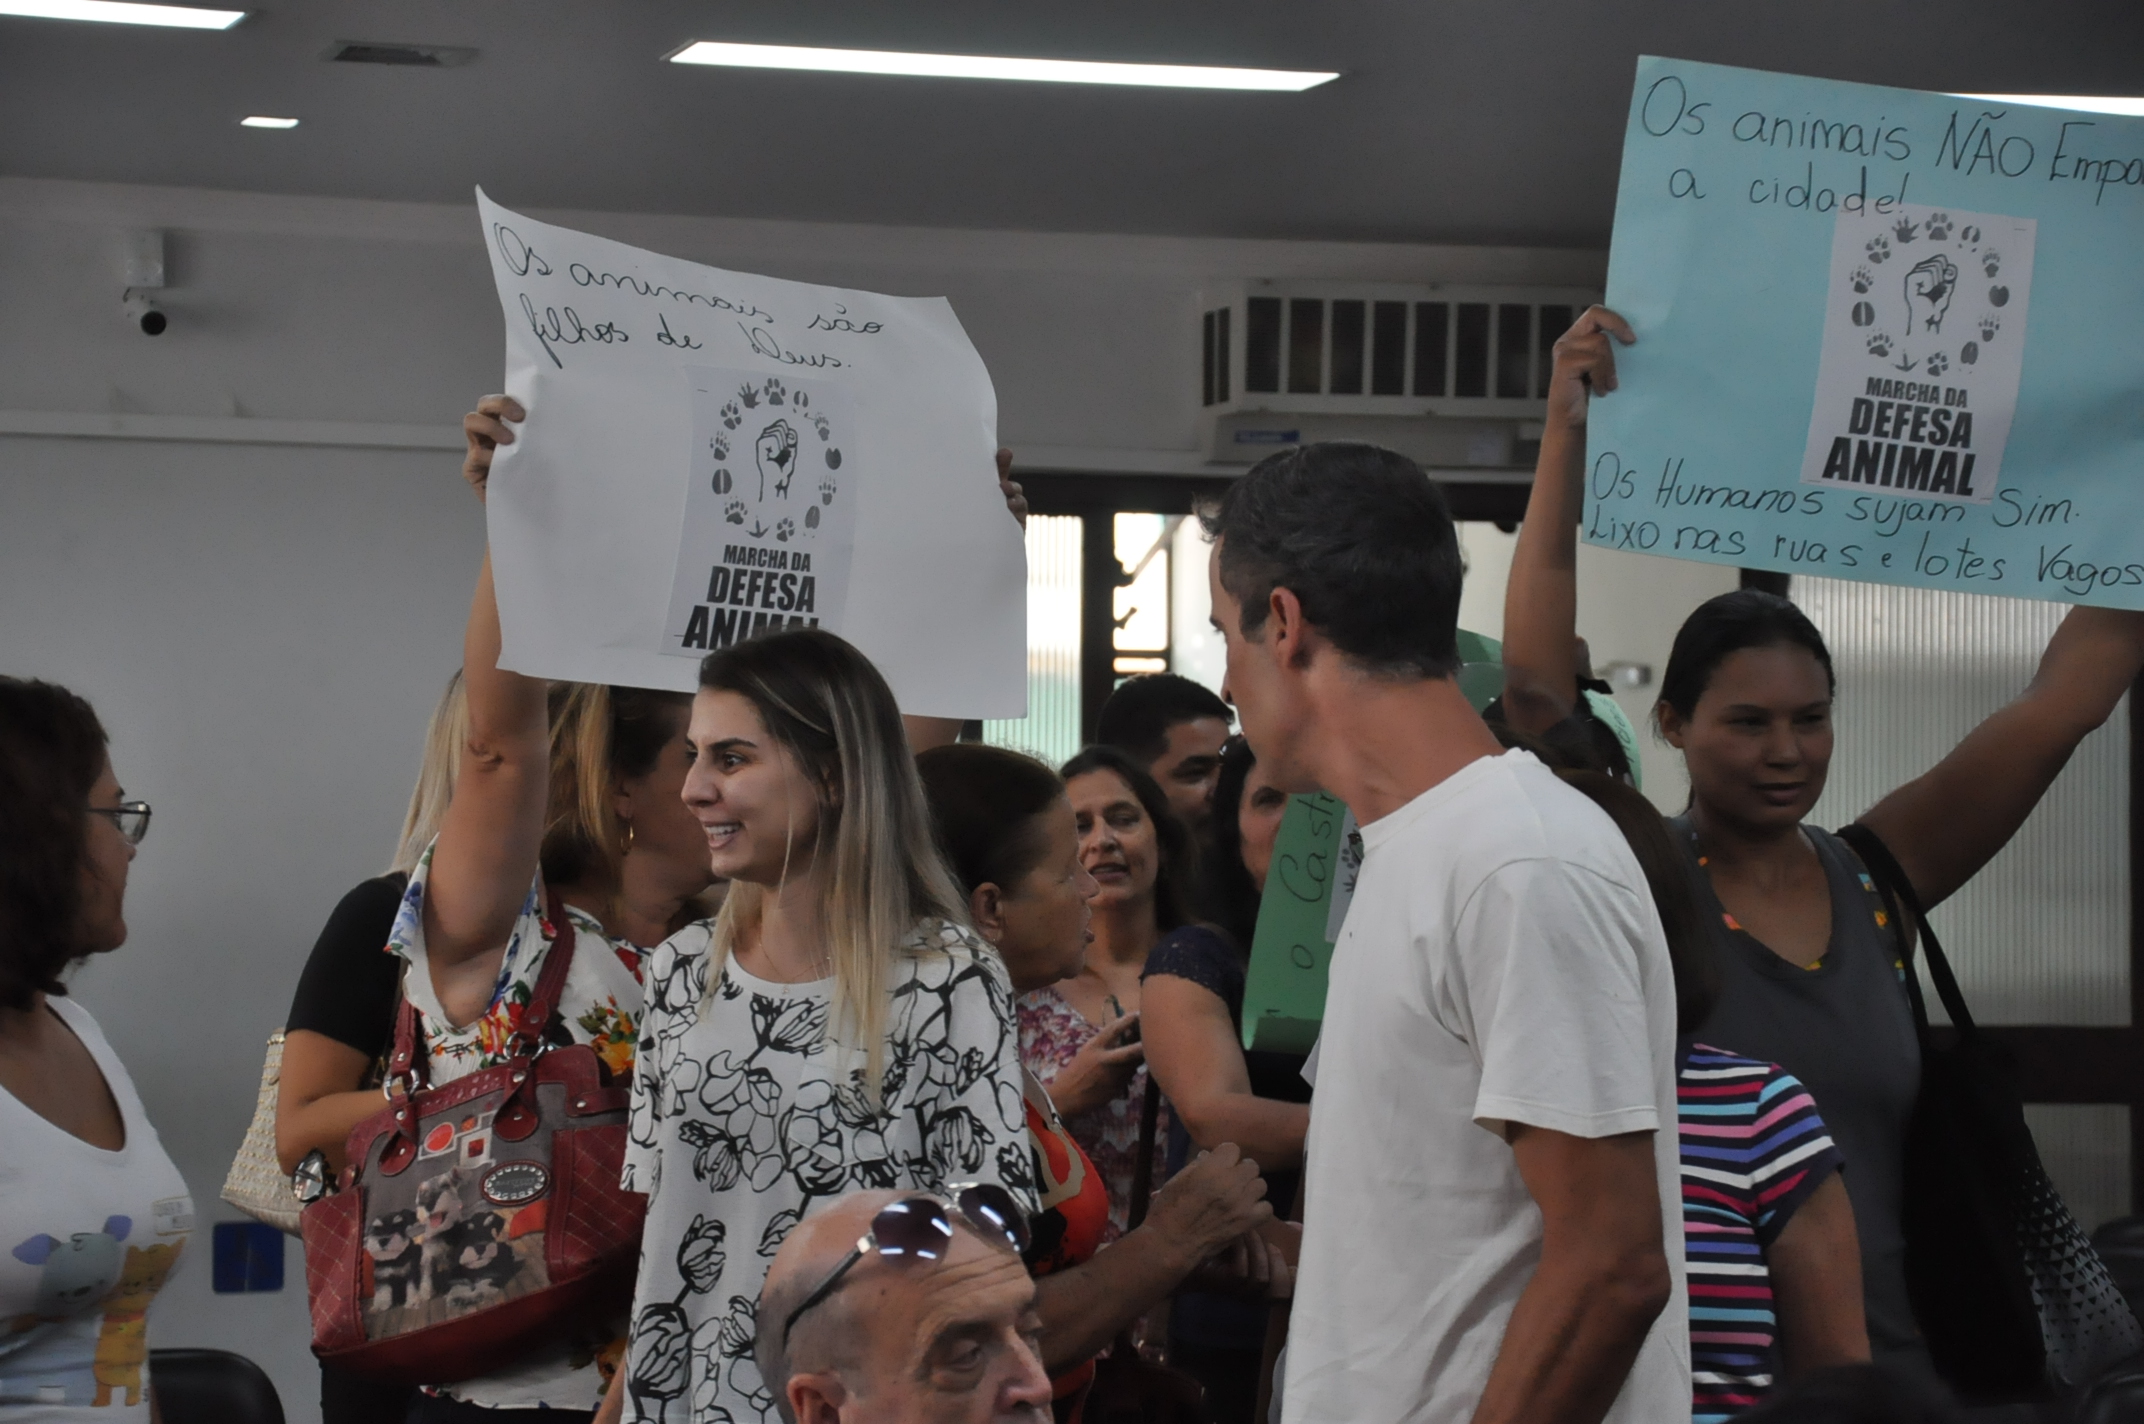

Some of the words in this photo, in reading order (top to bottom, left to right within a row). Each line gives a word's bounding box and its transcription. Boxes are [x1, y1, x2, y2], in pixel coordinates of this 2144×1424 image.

[1641, 75, 1712, 137] Os
[1732, 110, 1911, 161] animais
[1935, 109, 2035, 178] NÃO
[2049, 122, 2144, 206] Empo
[1668, 168, 1707, 199] a
[1749, 161, 1911, 217] cidade!
[493, 222, 553, 276] Os
[569, 263, 774, 323] animais
[807, 302, 884, 334] são
[519, 293, 630, 370] filhos
[656, 313, 703, 350] de
[737, 321, 852, 368] Deus.
[1865, 376, 1940, 404] MARCHA
[1943, 387, 1968, 408] DA
[1848, 397, 1973, 449] DEFESA
[1593, 451, 1637, 500] Os
[1655, 457, 1825, 515] Humanos
[1845, 496, 1966, 537] sujam
[1992, 488, 2080, 528] Sim.
[1821, 436, 1976, 496] ANIMAL
[723, 544, 788, 570] MARCHA
[791, 552, 811, 572] DA
[1589, 504, 1660, 549] Lixo
[1674, 526, 1746, 555] nas
[1773, 534, 1863, 567] ruas
[1881, 552, 1892, 568] e
[1914, 530, 2006, 581] lotes
[2037, 544, 2144, 595] Vagos
[706, 565, 816, 613] DEFESA
[681, 605, 819, 650] ANI
[1279, 790, 1335, 902] Castr
